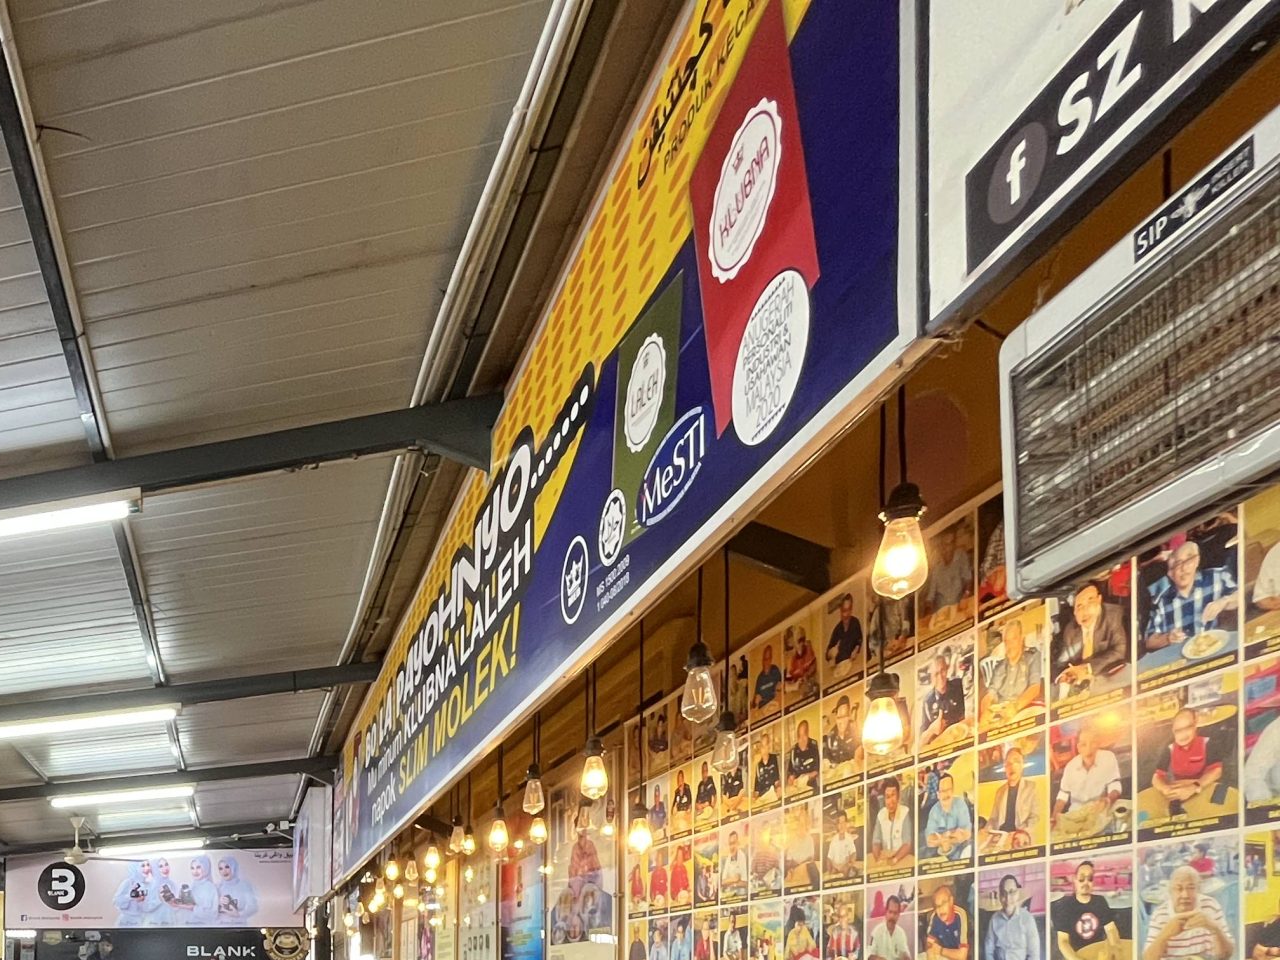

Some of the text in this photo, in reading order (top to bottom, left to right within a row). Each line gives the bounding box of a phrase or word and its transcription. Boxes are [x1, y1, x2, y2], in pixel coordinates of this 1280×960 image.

[664, 73, 712, 174] PRODUK
[1056, 9, 1144, 156] SZ
[719, 136, 770, 247] KLUBNA
[1136, 215, 1168, 256] SIP
[631, 368, 659, 418] LALEH
[642, 413, 705, 522] MeSTI
[404, 642, 457, 745] KLUBNA
[460, 518, 532, 667] LALEH
[398, 724, 429, 795] SLIM
[432, 602, 520, 757] MOLEK!
[186, 945, 256, 957] BLANK
